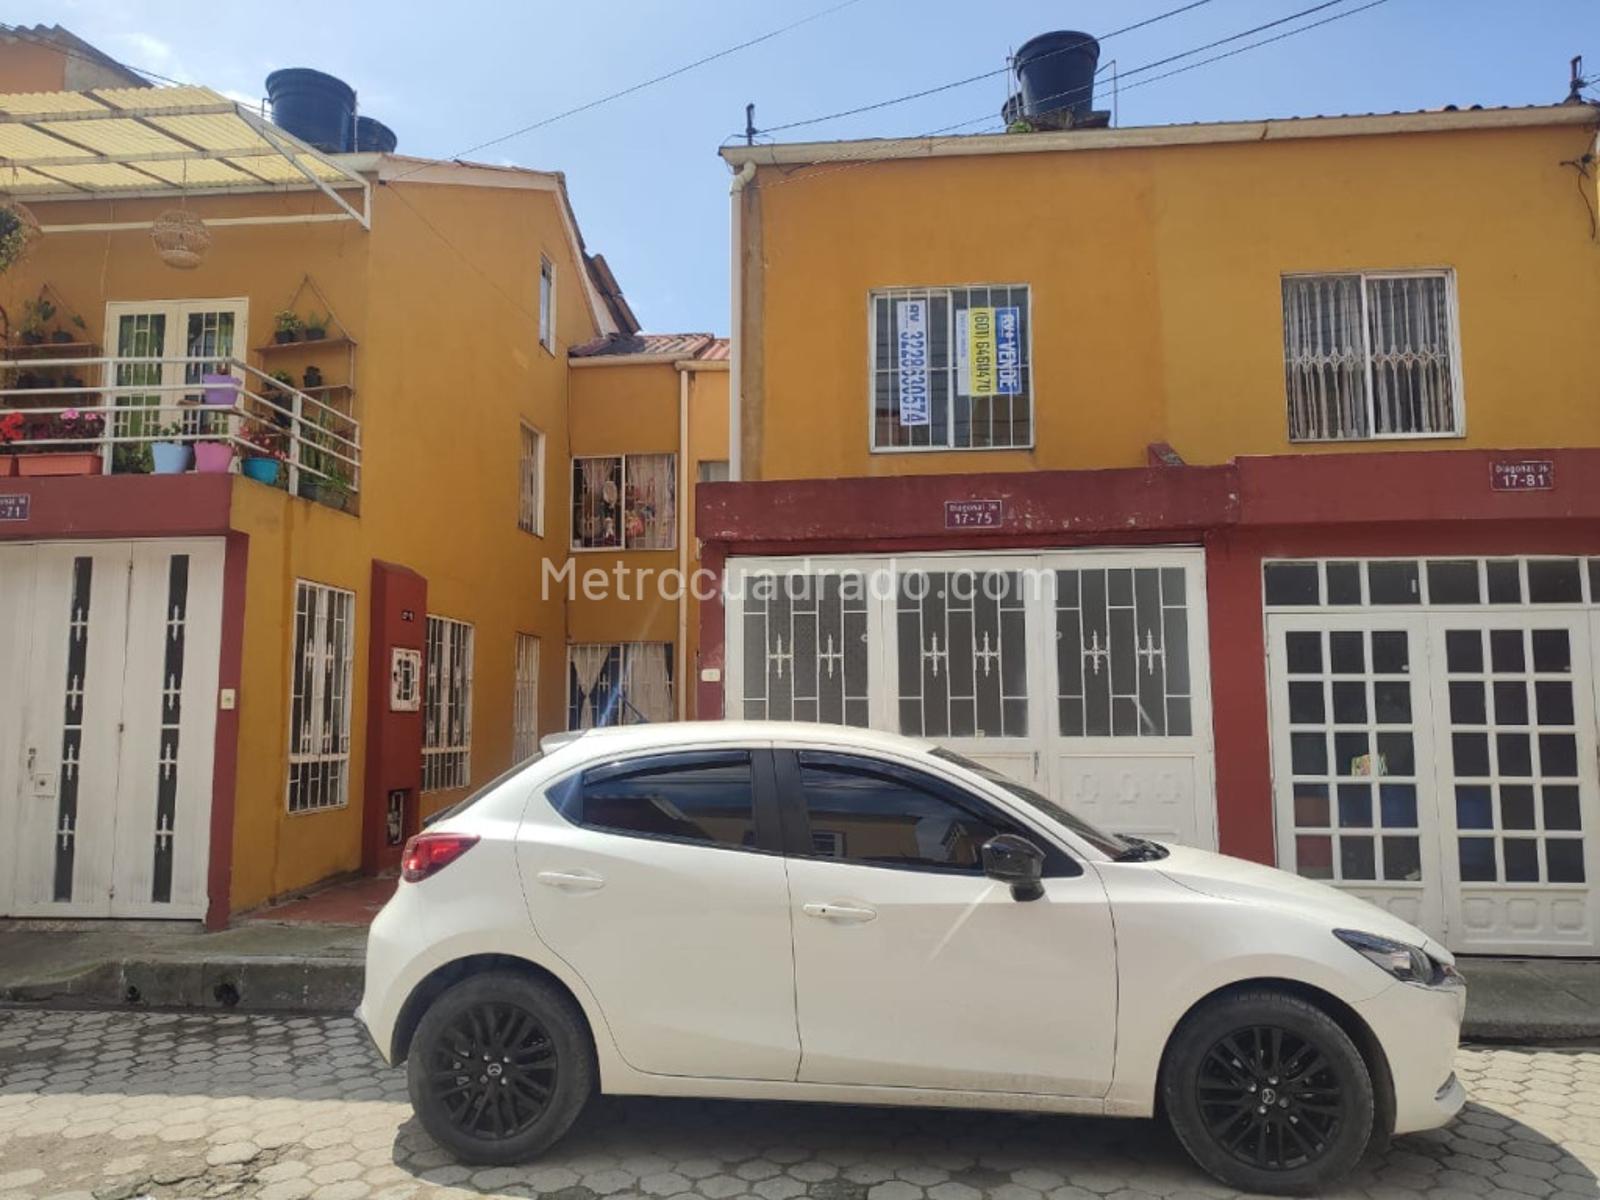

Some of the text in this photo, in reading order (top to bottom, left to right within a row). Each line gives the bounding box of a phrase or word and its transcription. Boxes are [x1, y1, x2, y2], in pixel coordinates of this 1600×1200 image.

[975, 311, 990, 340] (601)
[900, 331, 926, 423] 3228630574
[998, 341, 1017, 389] VENDE
[1503, 474, 1545, 487] 17-81
[955, 513, 992, 525] 17-75
